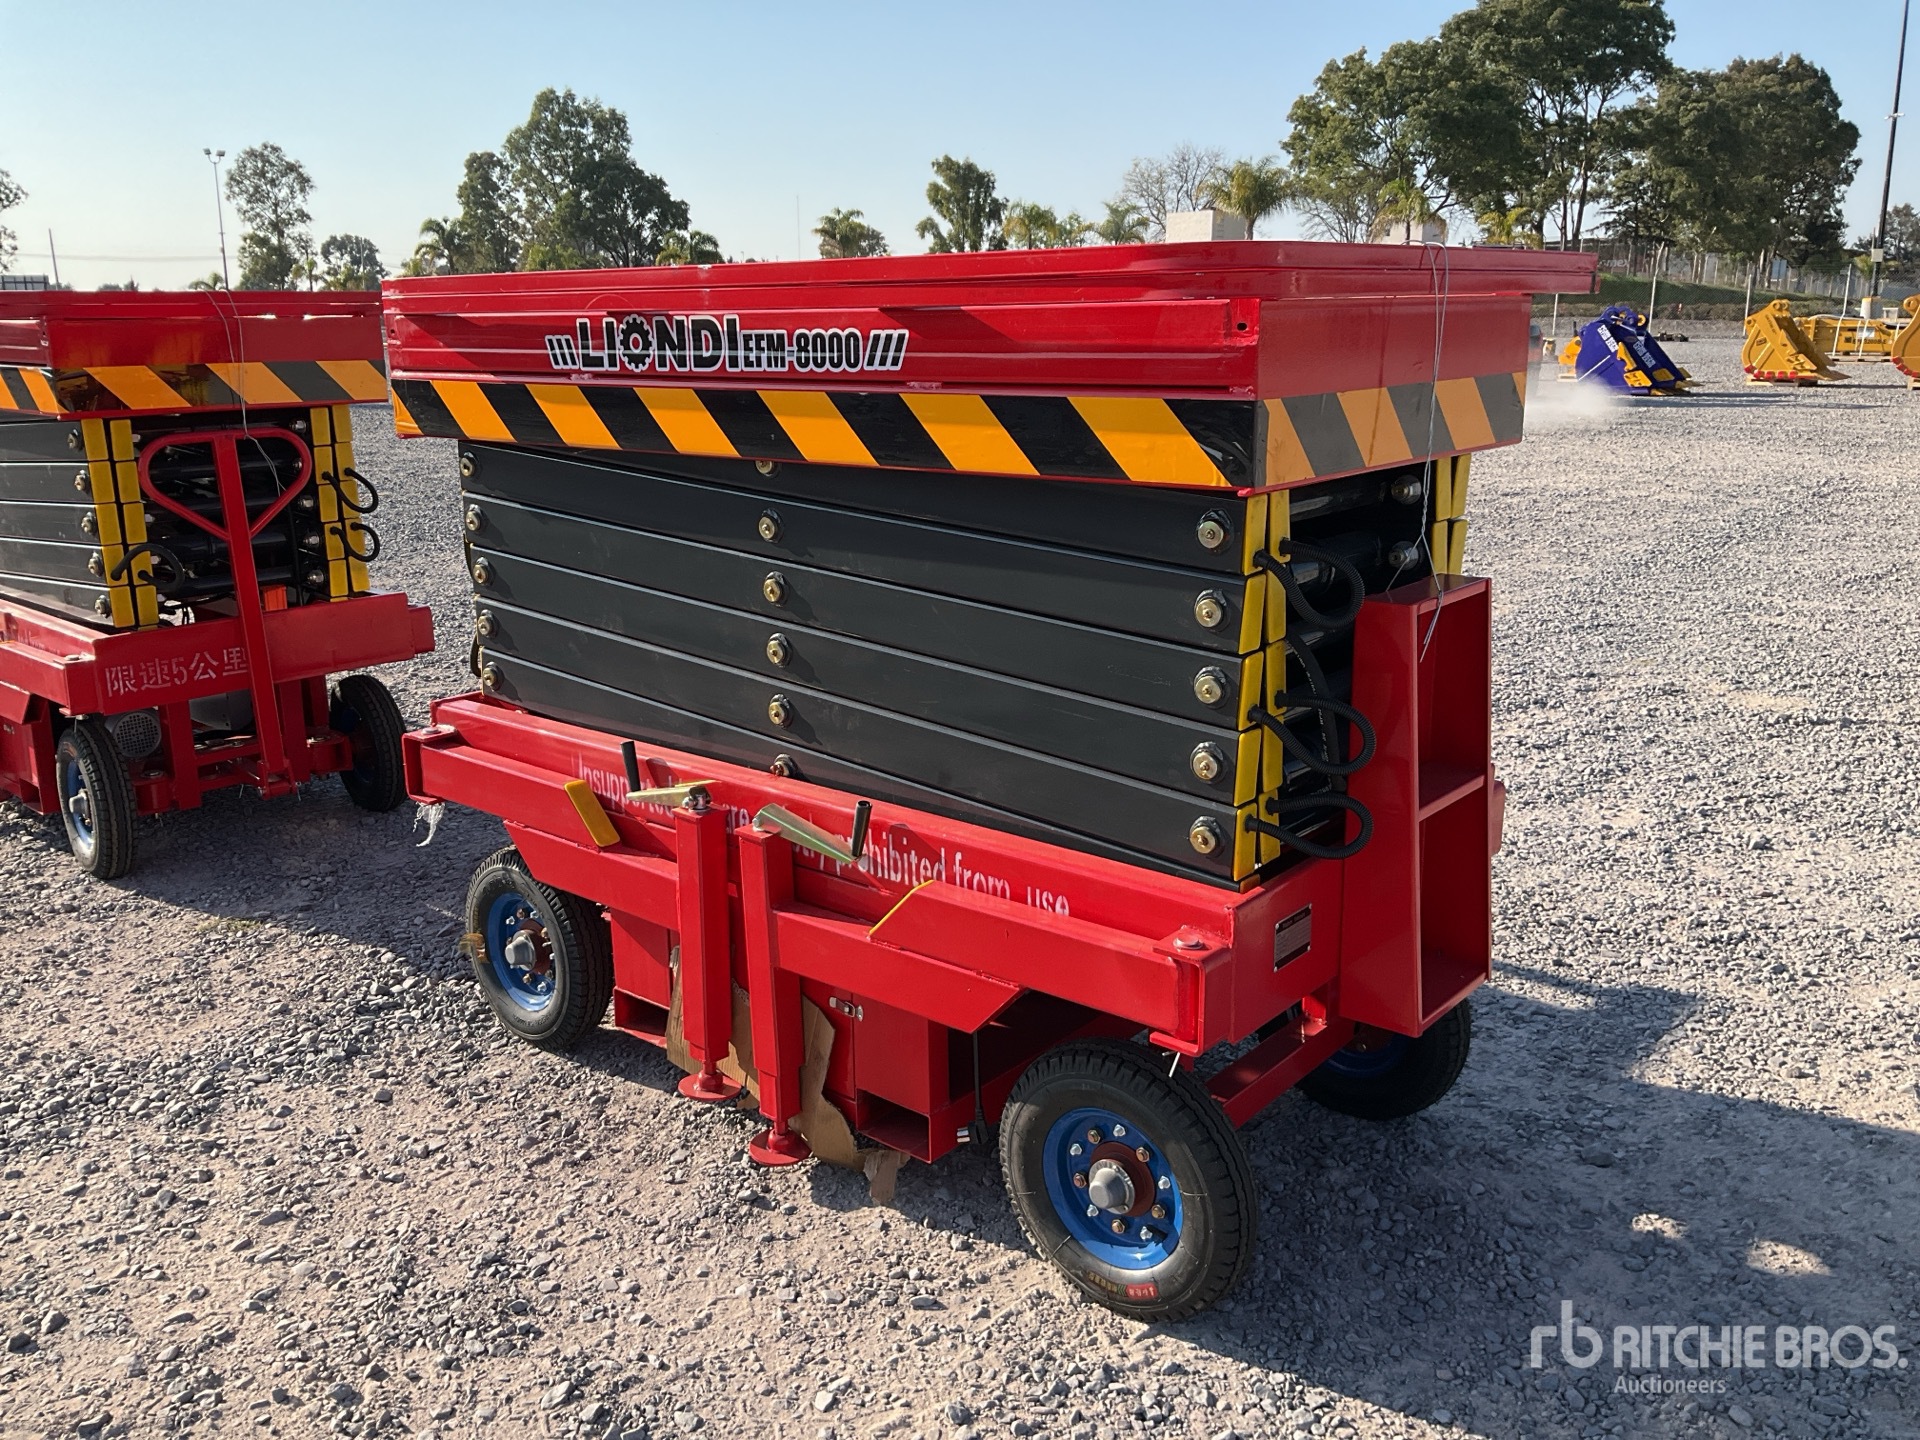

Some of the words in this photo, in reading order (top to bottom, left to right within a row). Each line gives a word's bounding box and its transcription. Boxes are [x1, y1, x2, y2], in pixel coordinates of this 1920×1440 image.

[577, 315, 740, 371] LIONDI
[741, 330, 861, 371] EFM-8000
[105, 647, 248, 697] 限速5公里
[953, 852, 1010, 899] from
[1027, 886, 1069, 916] use
